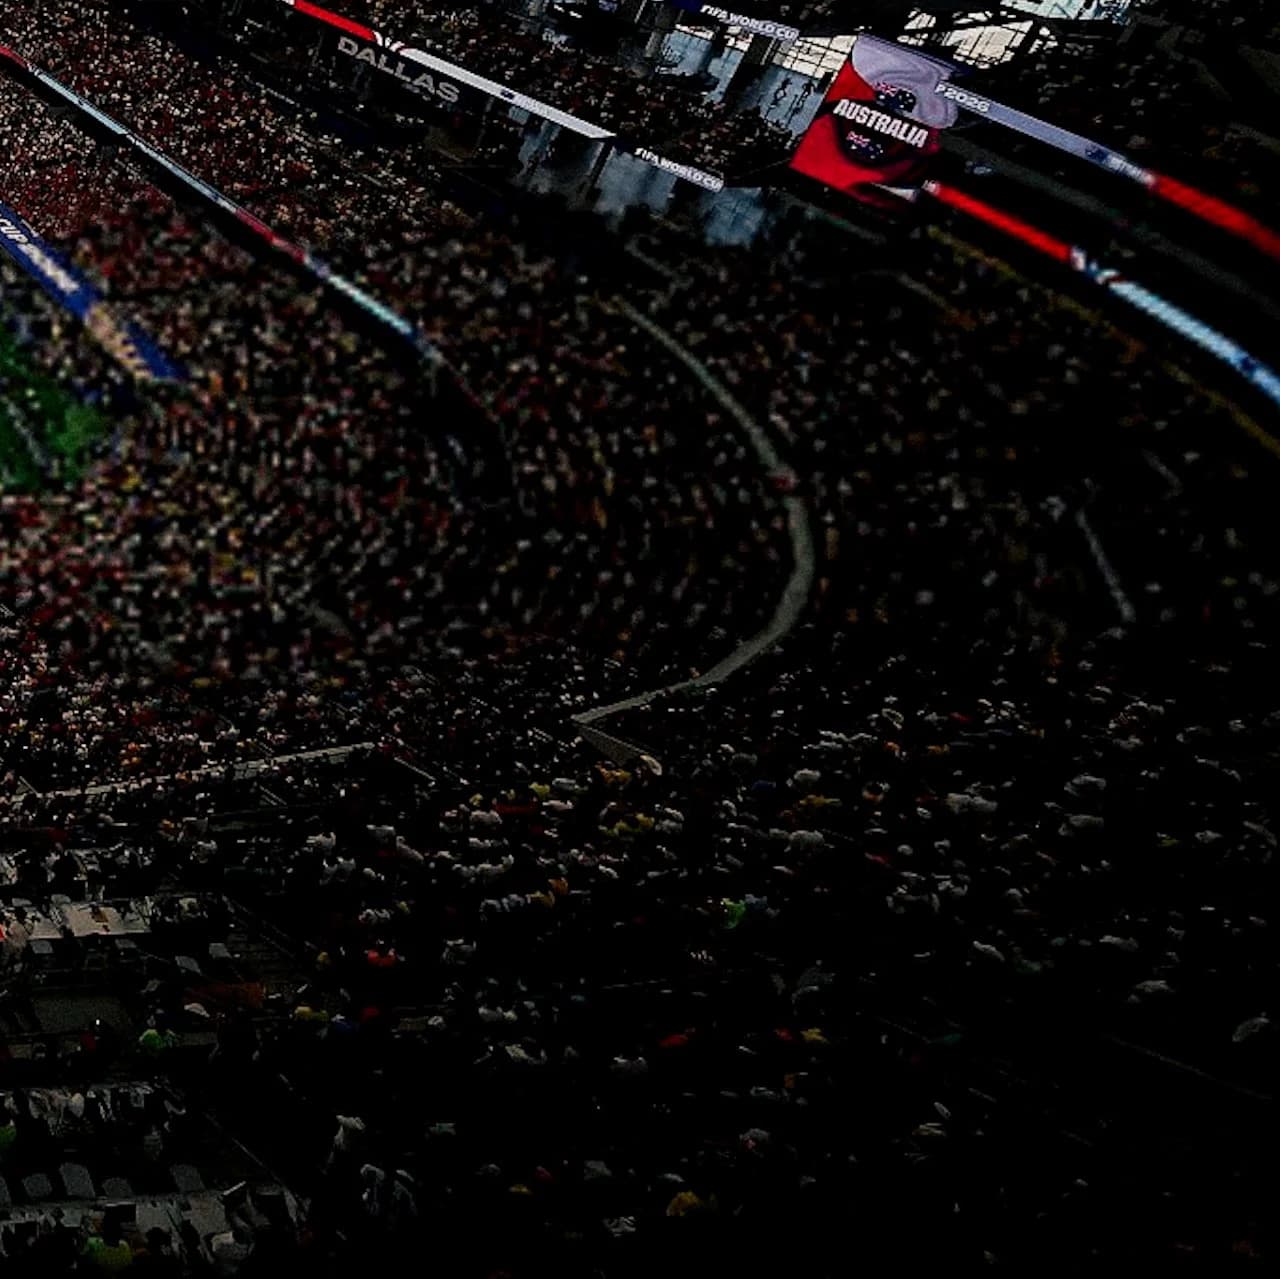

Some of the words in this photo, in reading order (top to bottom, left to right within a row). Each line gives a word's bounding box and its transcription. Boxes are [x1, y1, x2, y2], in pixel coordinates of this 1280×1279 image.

[699, 3, 728, 20] FIFA
[728, 10, 776, 34] WORLD
[336, 34, 461, 104] DALLAS
[832, 97, 929, 149] AUSTRALIA
